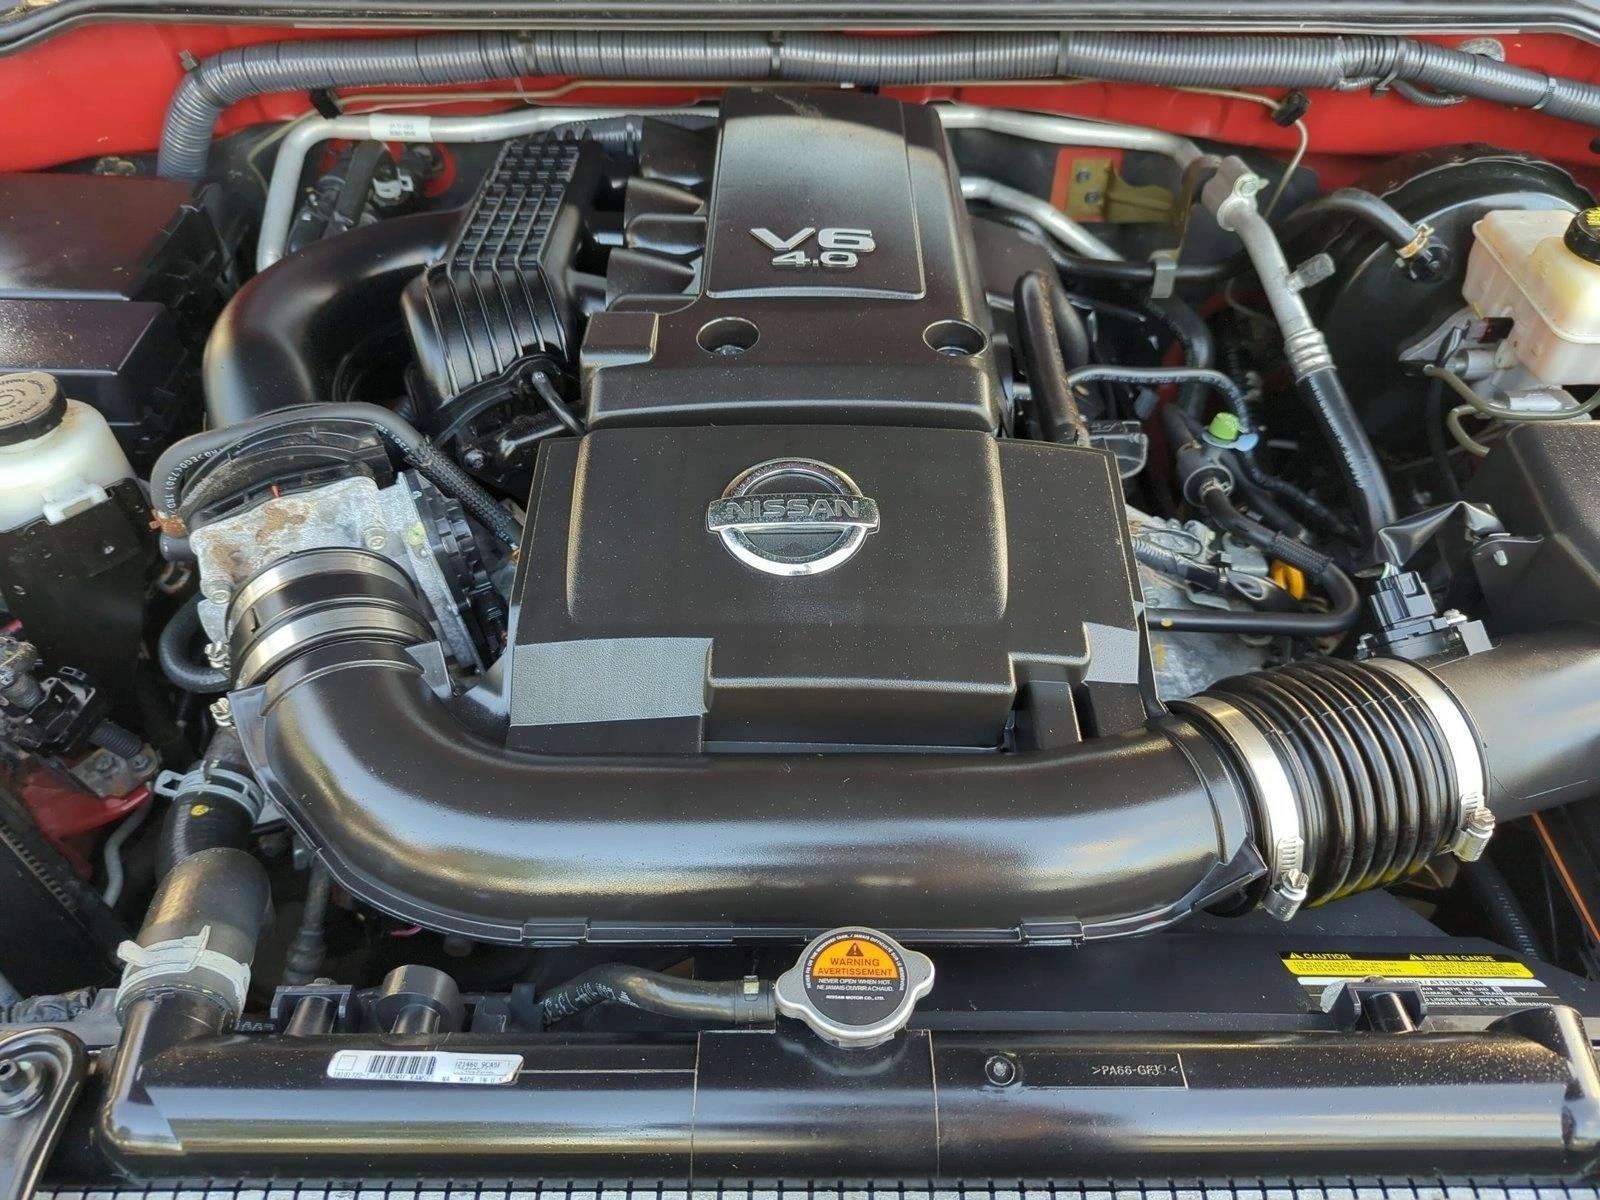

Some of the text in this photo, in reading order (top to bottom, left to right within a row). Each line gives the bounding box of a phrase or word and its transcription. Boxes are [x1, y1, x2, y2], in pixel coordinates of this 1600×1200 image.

[749, 227, 876, 252] V6
[772, 250, 858, 268] 4.0
[728, 499, 859, 519] NISSAN
[818, 967, 893, 976] AVERTISSEMENT
[830, 958, 881, 967] WARNING
